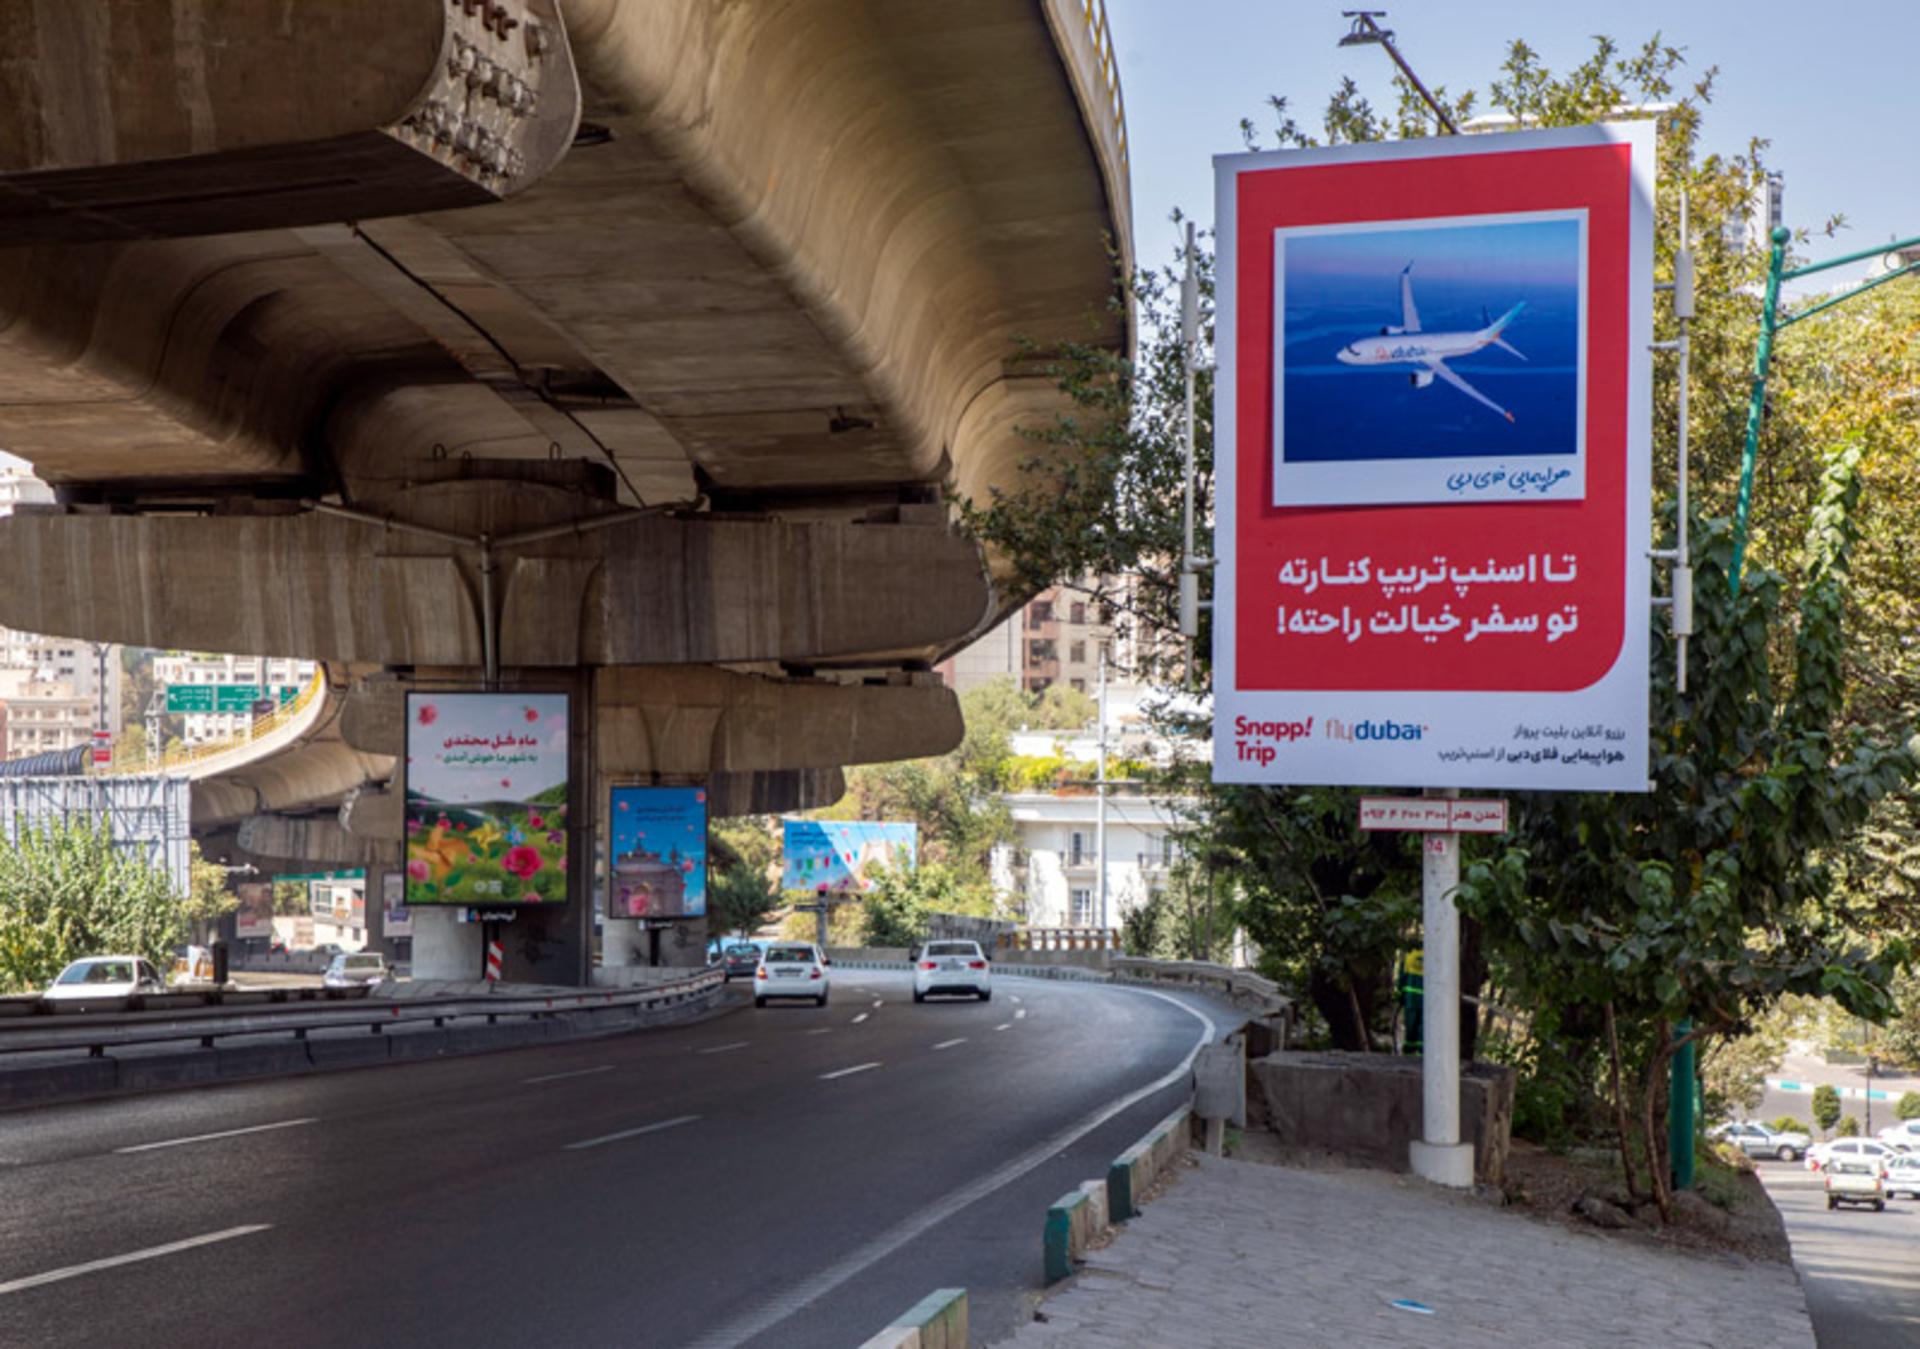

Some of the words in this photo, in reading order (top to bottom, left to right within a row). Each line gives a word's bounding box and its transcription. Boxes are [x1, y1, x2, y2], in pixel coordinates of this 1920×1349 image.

[1278, 557, 1371, 594] کنارته
[1542, 554, 1577, 582] تا
[1277, 605, 1362, 642] راحته!
[1369, 605, 1461, 643] خیالت
[1464, 604, 1539, 642] سفر
[1546, 605, 1579, 643] تو
[1234, 715, 1313, 742] Snapp!
[1513, 723, 1540, 741] پرواز
[1234, 740, 1277, 768] Trip
[1561, 748, 1625, 767] هواپیمایی
